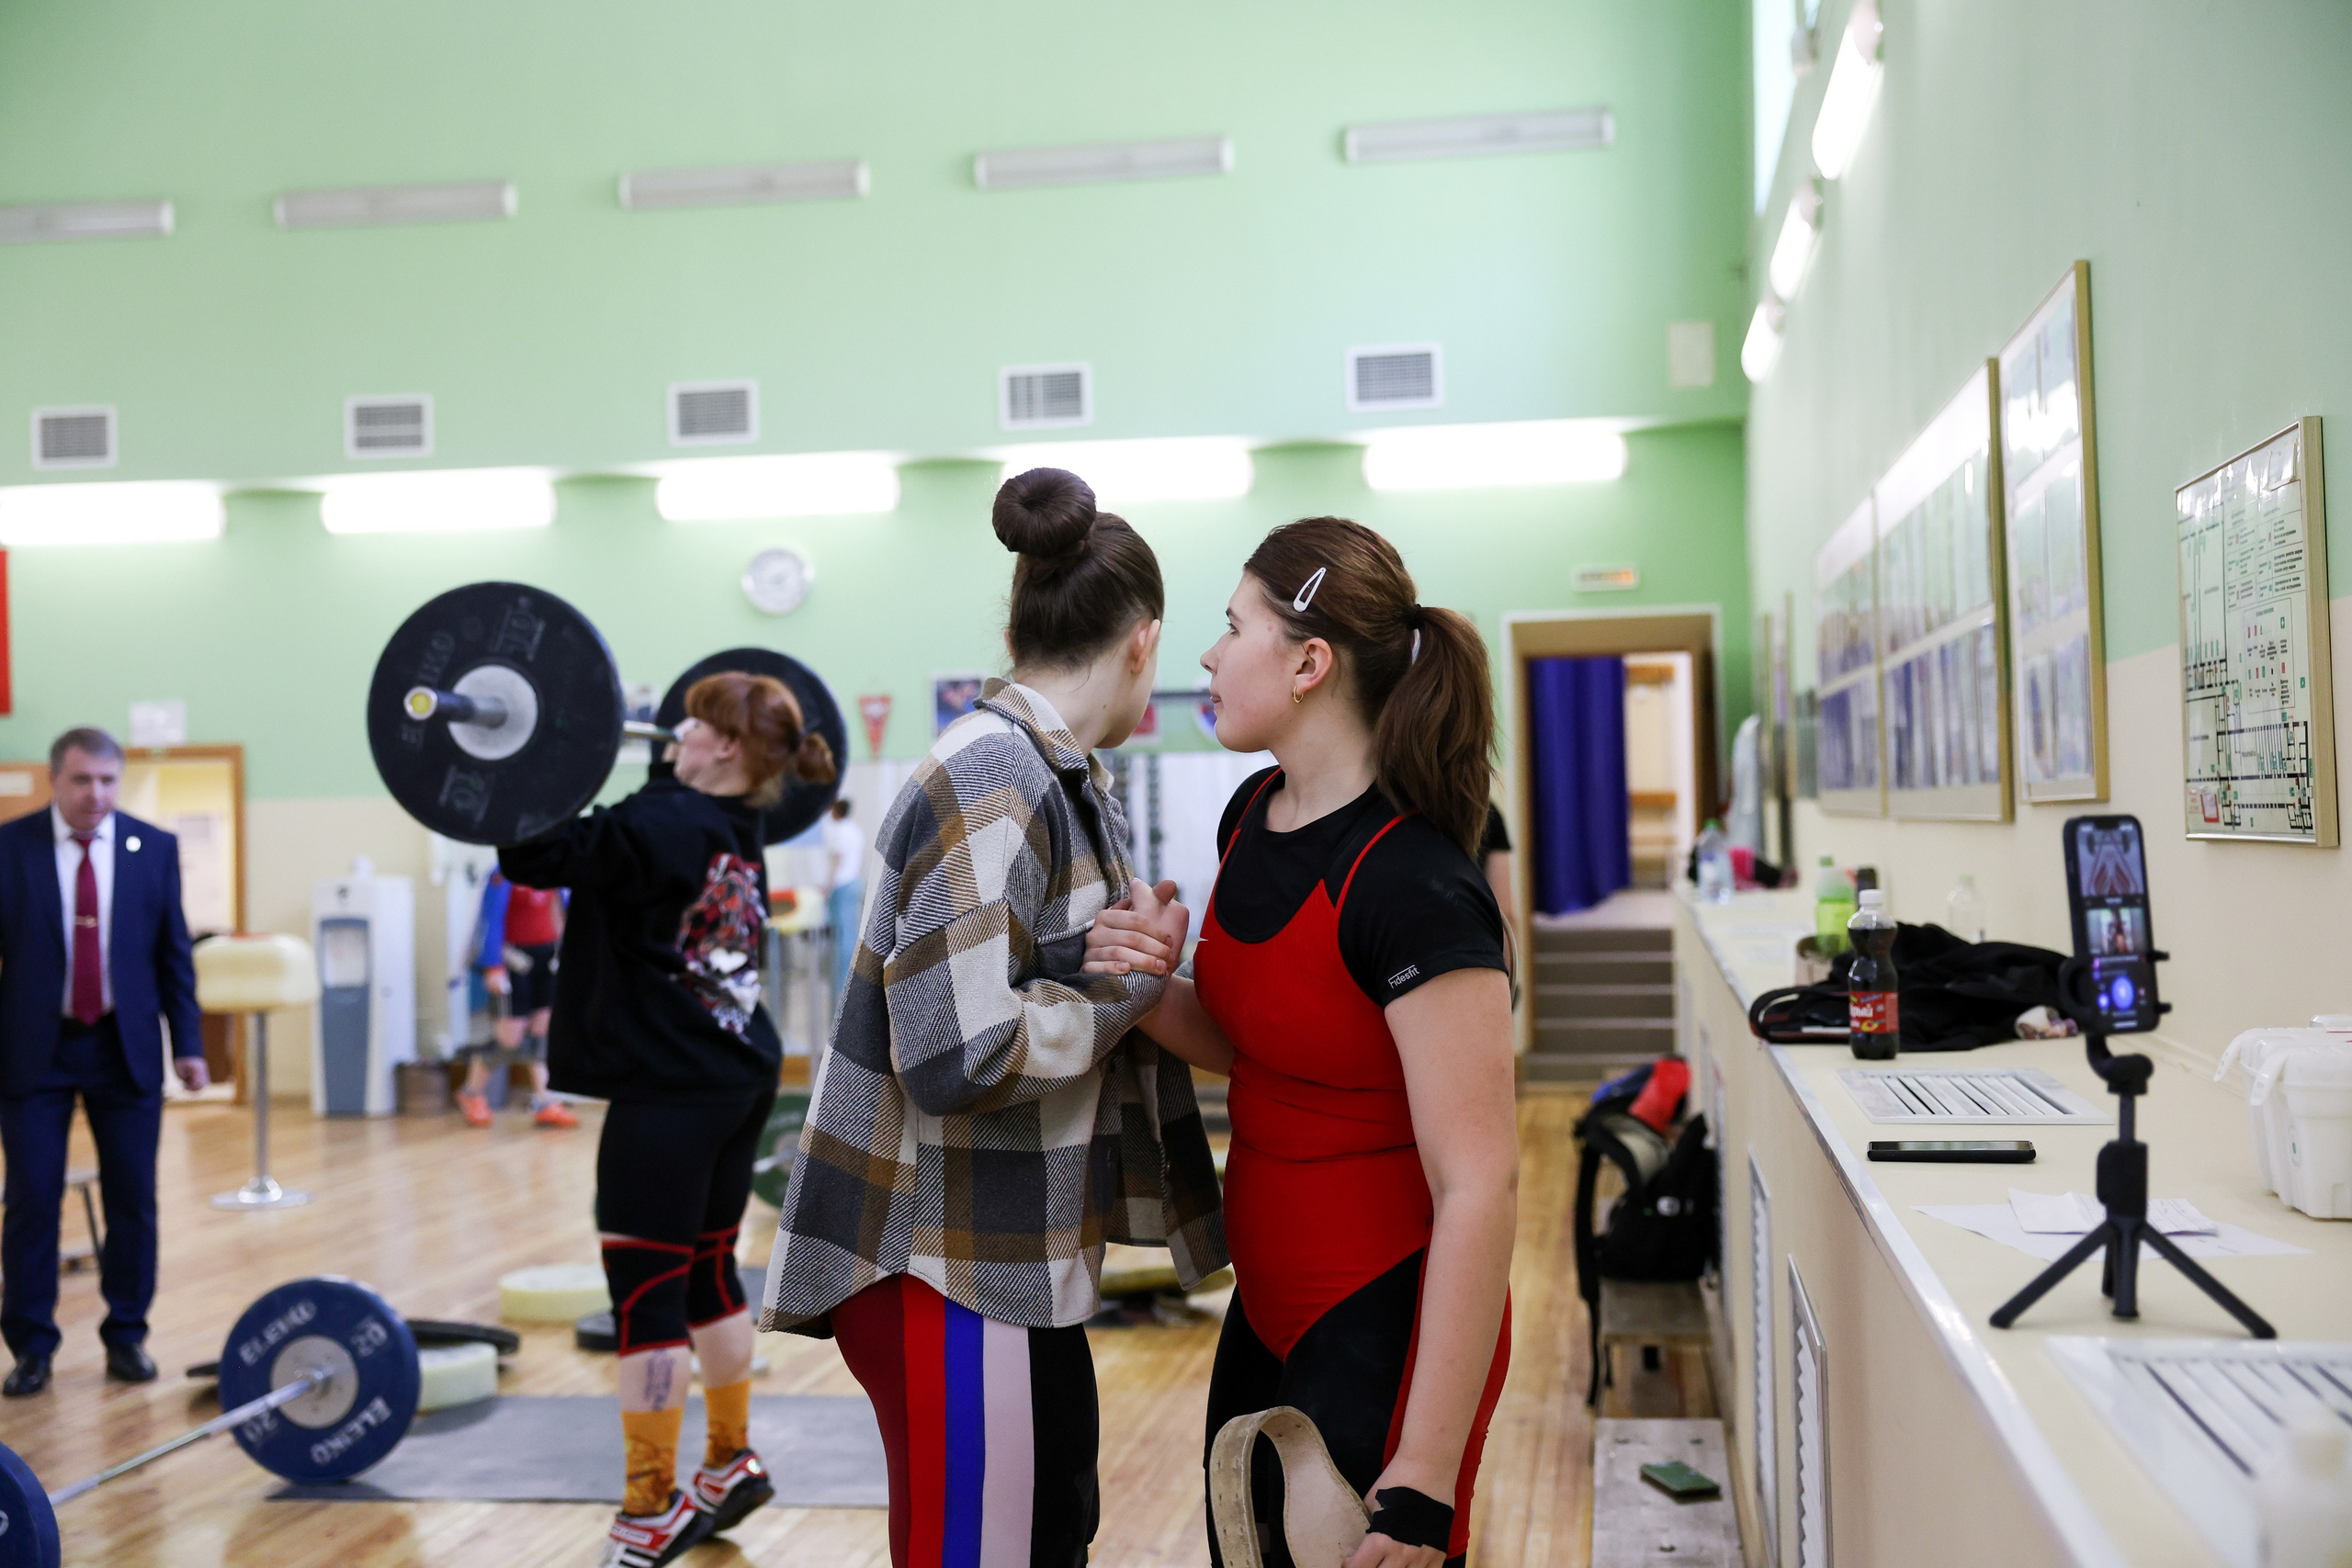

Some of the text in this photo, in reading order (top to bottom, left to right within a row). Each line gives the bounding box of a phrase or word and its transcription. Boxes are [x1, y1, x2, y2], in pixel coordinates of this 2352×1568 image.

[1387, 964, 1420, 989] Fidesfit
[239, 1298, 317, 1366] ELEIKO
[349, 1315, 389, 1357] 20
[309, 1395, 392, 1465] ELEIKO
